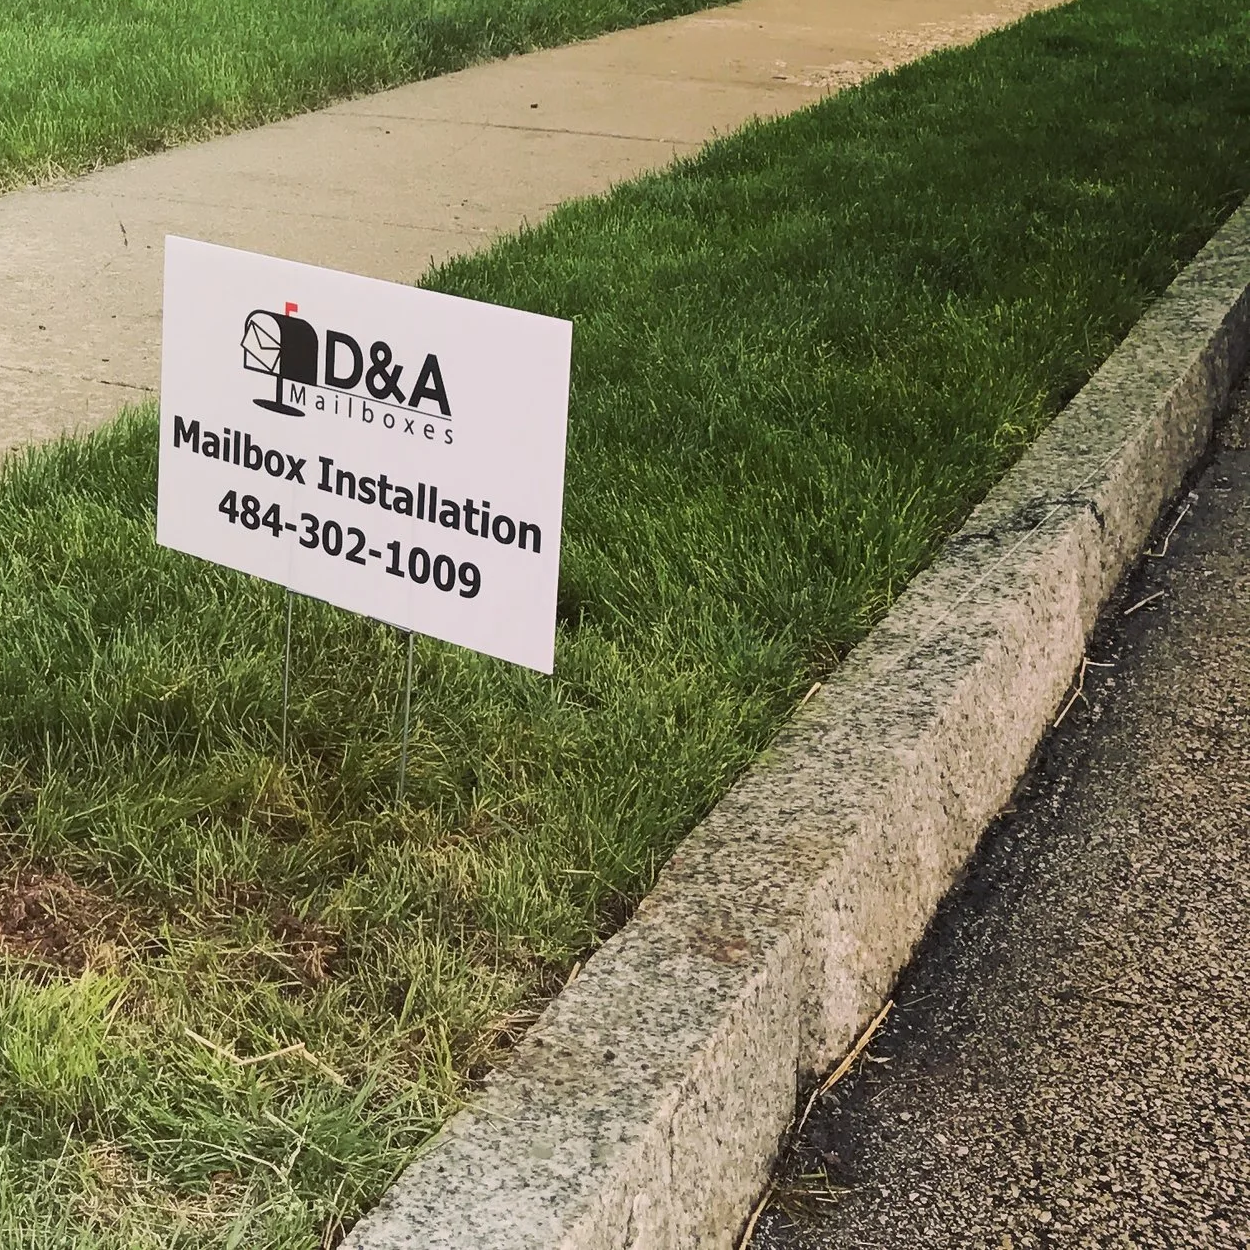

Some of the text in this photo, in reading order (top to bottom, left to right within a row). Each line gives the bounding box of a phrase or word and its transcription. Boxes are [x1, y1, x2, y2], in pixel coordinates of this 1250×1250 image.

[290, 384, 453, 444] Mailboxes
[324, 330, 451, 416] D&A
[174, 415, 541, 553] Mailbox Installation
[219, 491, 481, 598] 484-302-1009
